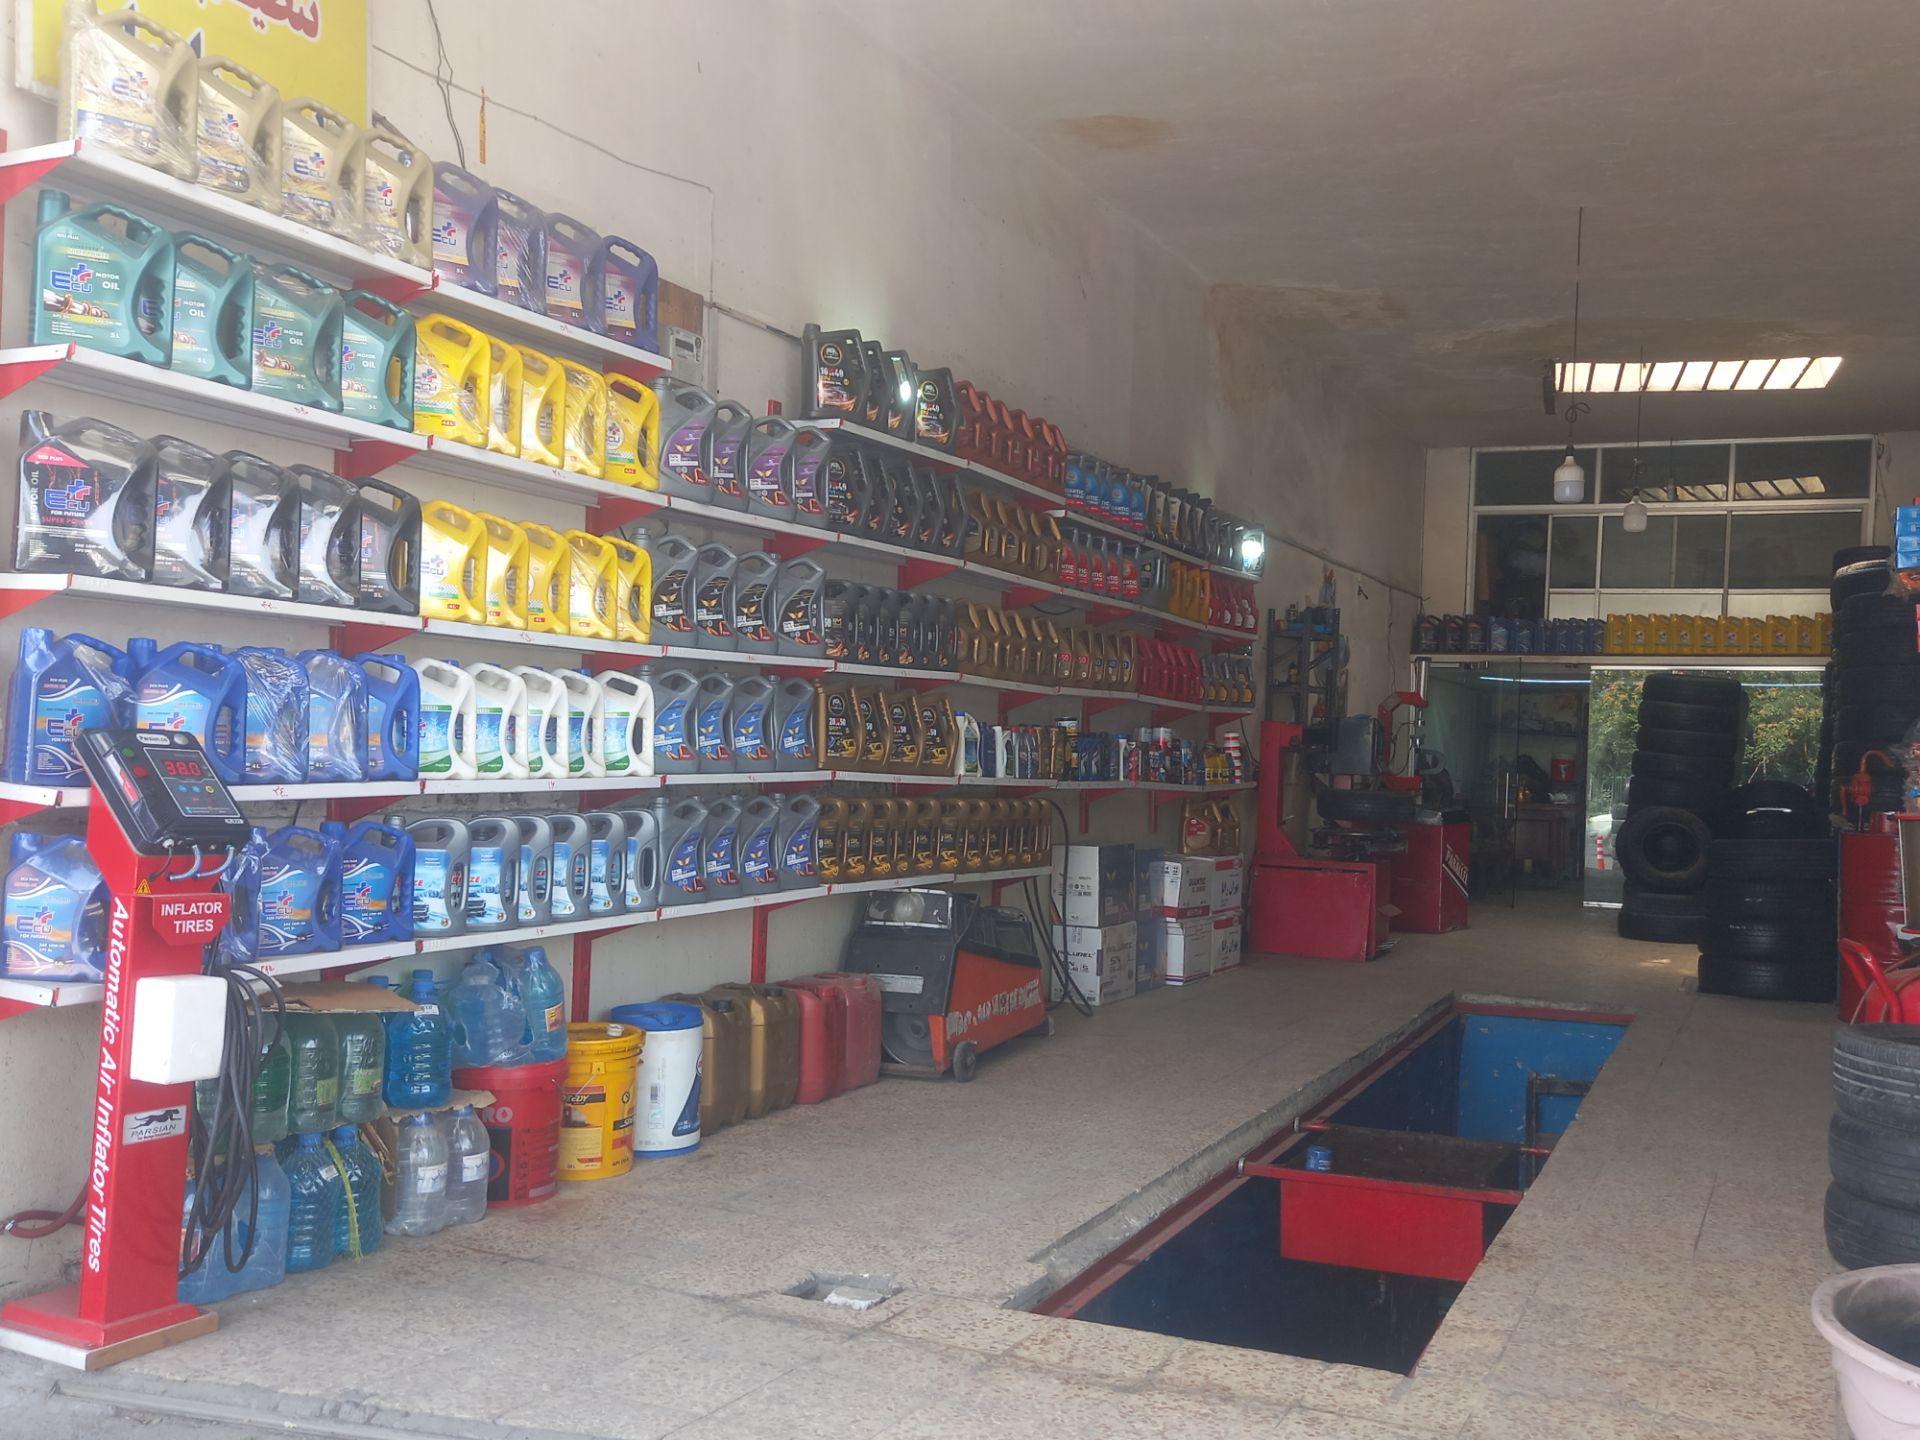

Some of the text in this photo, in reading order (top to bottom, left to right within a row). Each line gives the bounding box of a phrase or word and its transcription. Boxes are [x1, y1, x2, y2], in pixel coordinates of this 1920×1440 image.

[51, 267, 92, 293] ECU
[95, 272, 120, 280] MOTOR
[102, 281, 120, 291] OIL
[183, 300, 205, 308] MOTOR
[189, 309, 206, 318] OIL
[283, 329, 304, 337] MOTOR
[289, 338, 304, 346] OIL
[362, 360, 376, 369] OIL
[29, 470, 39, 521] MOTOR OIL
[44, 484, 90, 512] ECU
[63, 510, 85, 518] FUTURE
[161, 902, 222, 916] INFLATOR
[174, 919, 214, 933] TIRES
[88, 896, 130, 1273] Automatic Air Inflator Tires
[130, 1123, 177, 1138] PARSIAN
